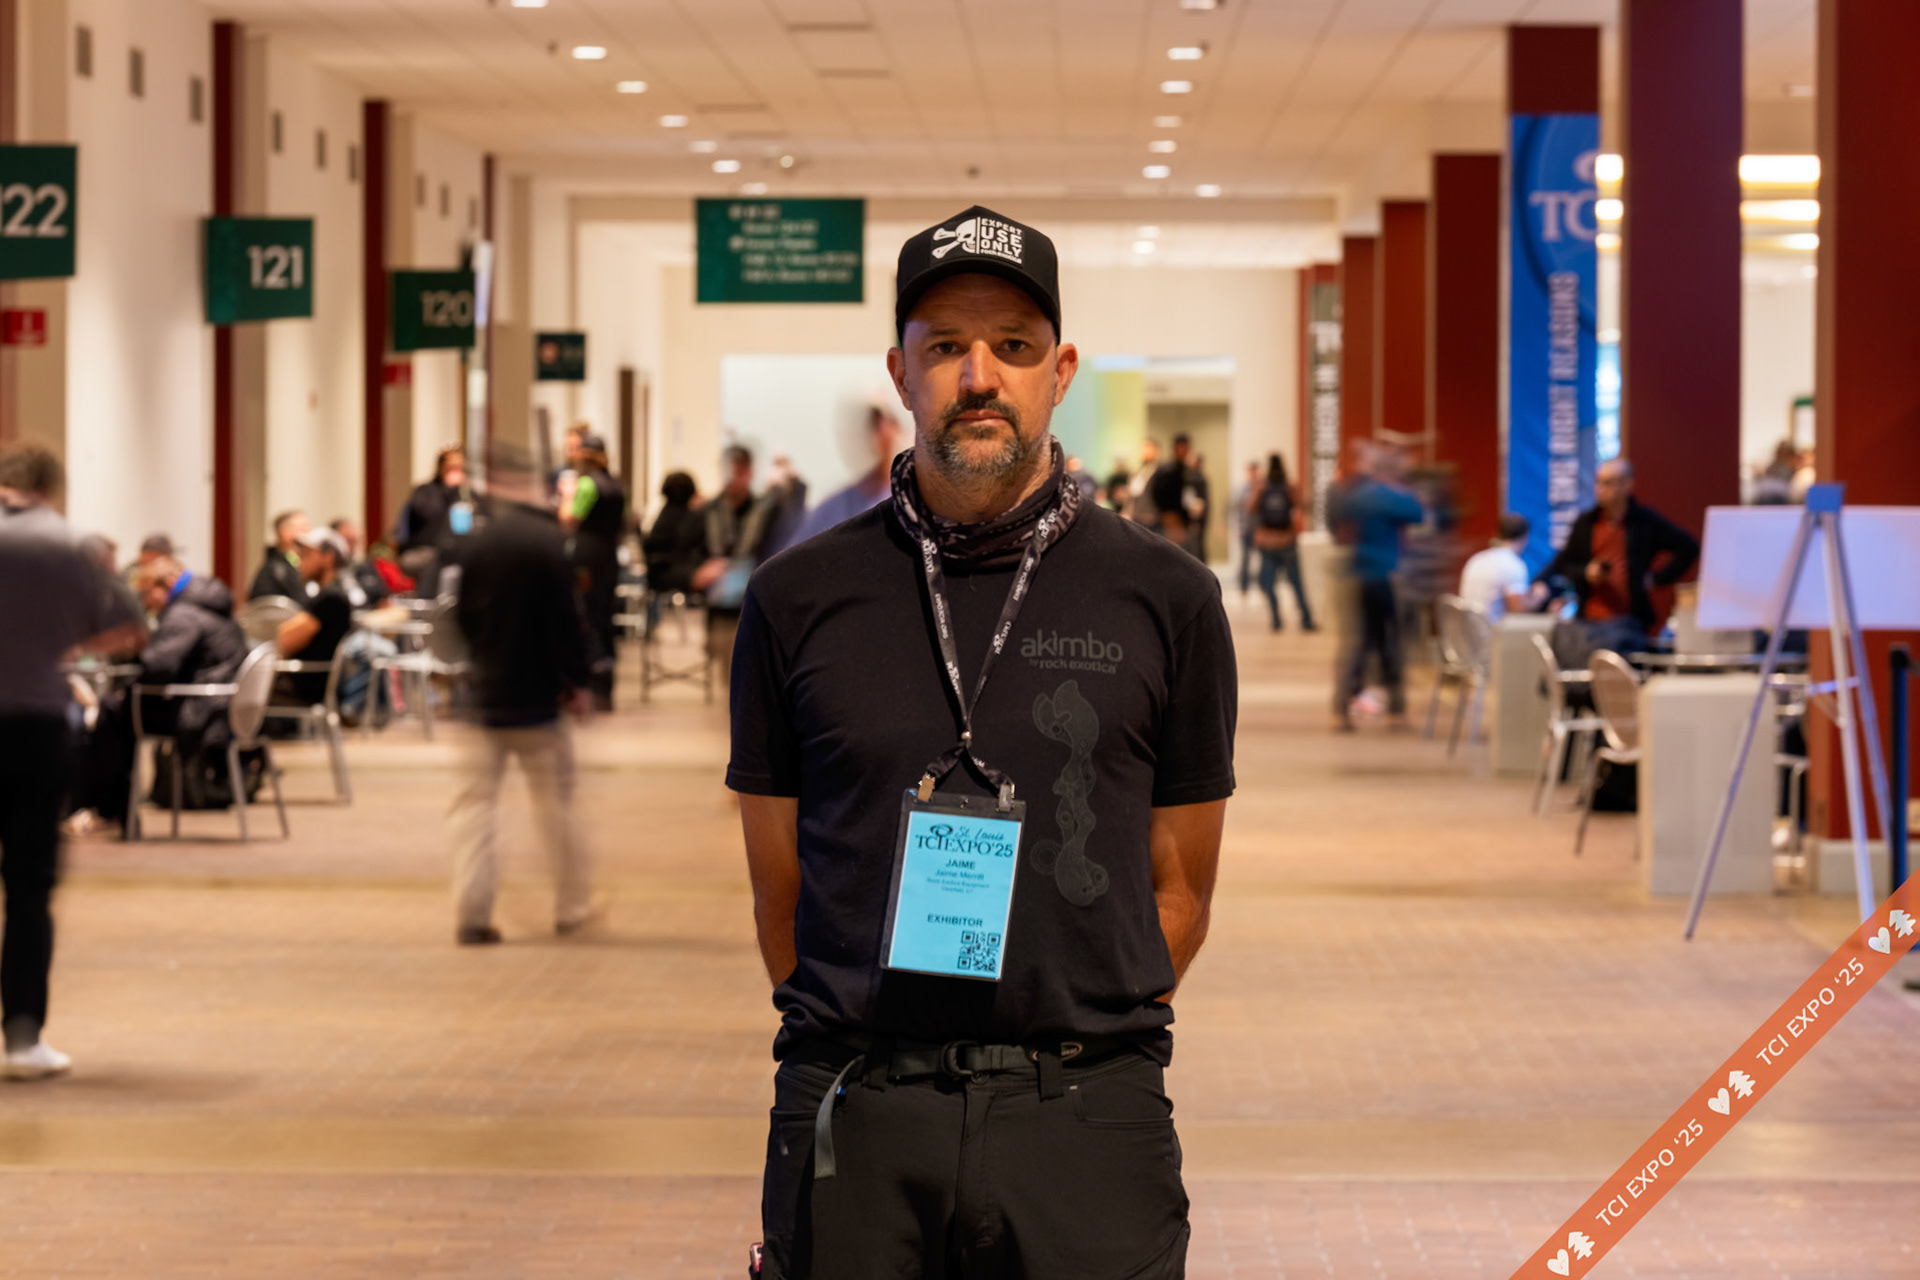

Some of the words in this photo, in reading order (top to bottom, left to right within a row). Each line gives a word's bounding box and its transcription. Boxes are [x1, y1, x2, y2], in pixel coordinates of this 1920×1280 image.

[0, 183, 68, 237] 22
[981, 218, 1022, 235] EXPERT
[981, 226, 1022, 248] USE
[980, 239, 1022, 258] ONLY
[246, 245, 304, 289] 121
[421, 290, 475, 327] 120
[1020, 629, 1123, 662] akimbo
[1040, 658, 1067, 670] rock
[975, 828, 1004, 841] Louis
[945, 859, 976, 870] JAIME
[927, 914, 983, 928] EXHIBITOR
